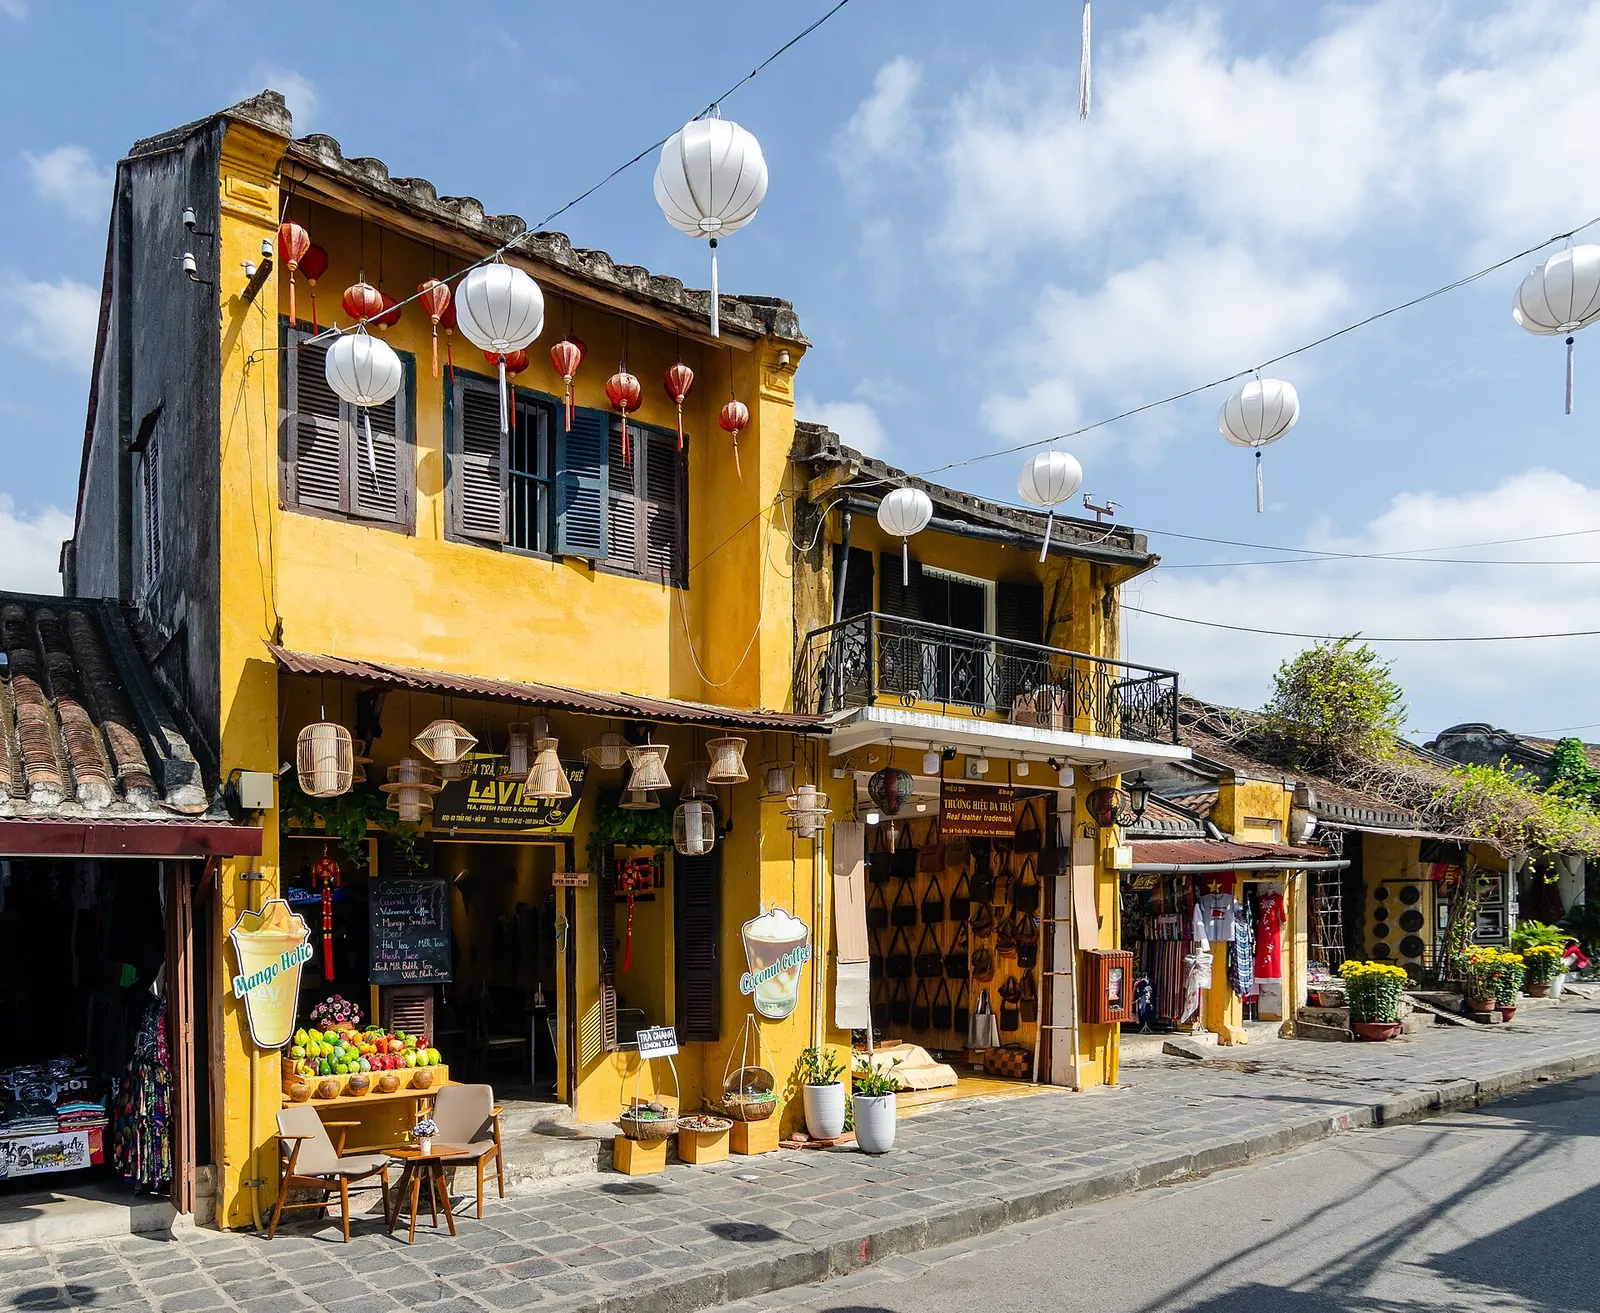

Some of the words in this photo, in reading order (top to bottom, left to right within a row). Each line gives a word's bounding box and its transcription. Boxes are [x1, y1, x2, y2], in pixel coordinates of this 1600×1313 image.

[569, 769, 584, 782] PHÊ
[998, 788, 1014, 796] Shop
[989, 802, 998, 811] DA
[946, 812, 960, 820] Real
[961, 813, 982, 821] leather
[983, 814, 1013, 823] trademark
[378, 881, 416, 895] Coconut
[379, 896, 405, 907] Coconut
[382, 917, 405, 932] Mango
[383, 928, 404, 939] Beer
[396, 939, 410, 950] Tea
[434, 937, 445, 947] Tea
[381, 949, 401, 960] Fresh
[234, 962, 278, 997] Mango
[280, 943, 312, 971] Holic
[421, 960, 433, 969] Tea
[742, 961, 780, 991] Coconut
[781, 946, 810, 970] Coffee
[653, 1030, 673, 1040] CHANH
